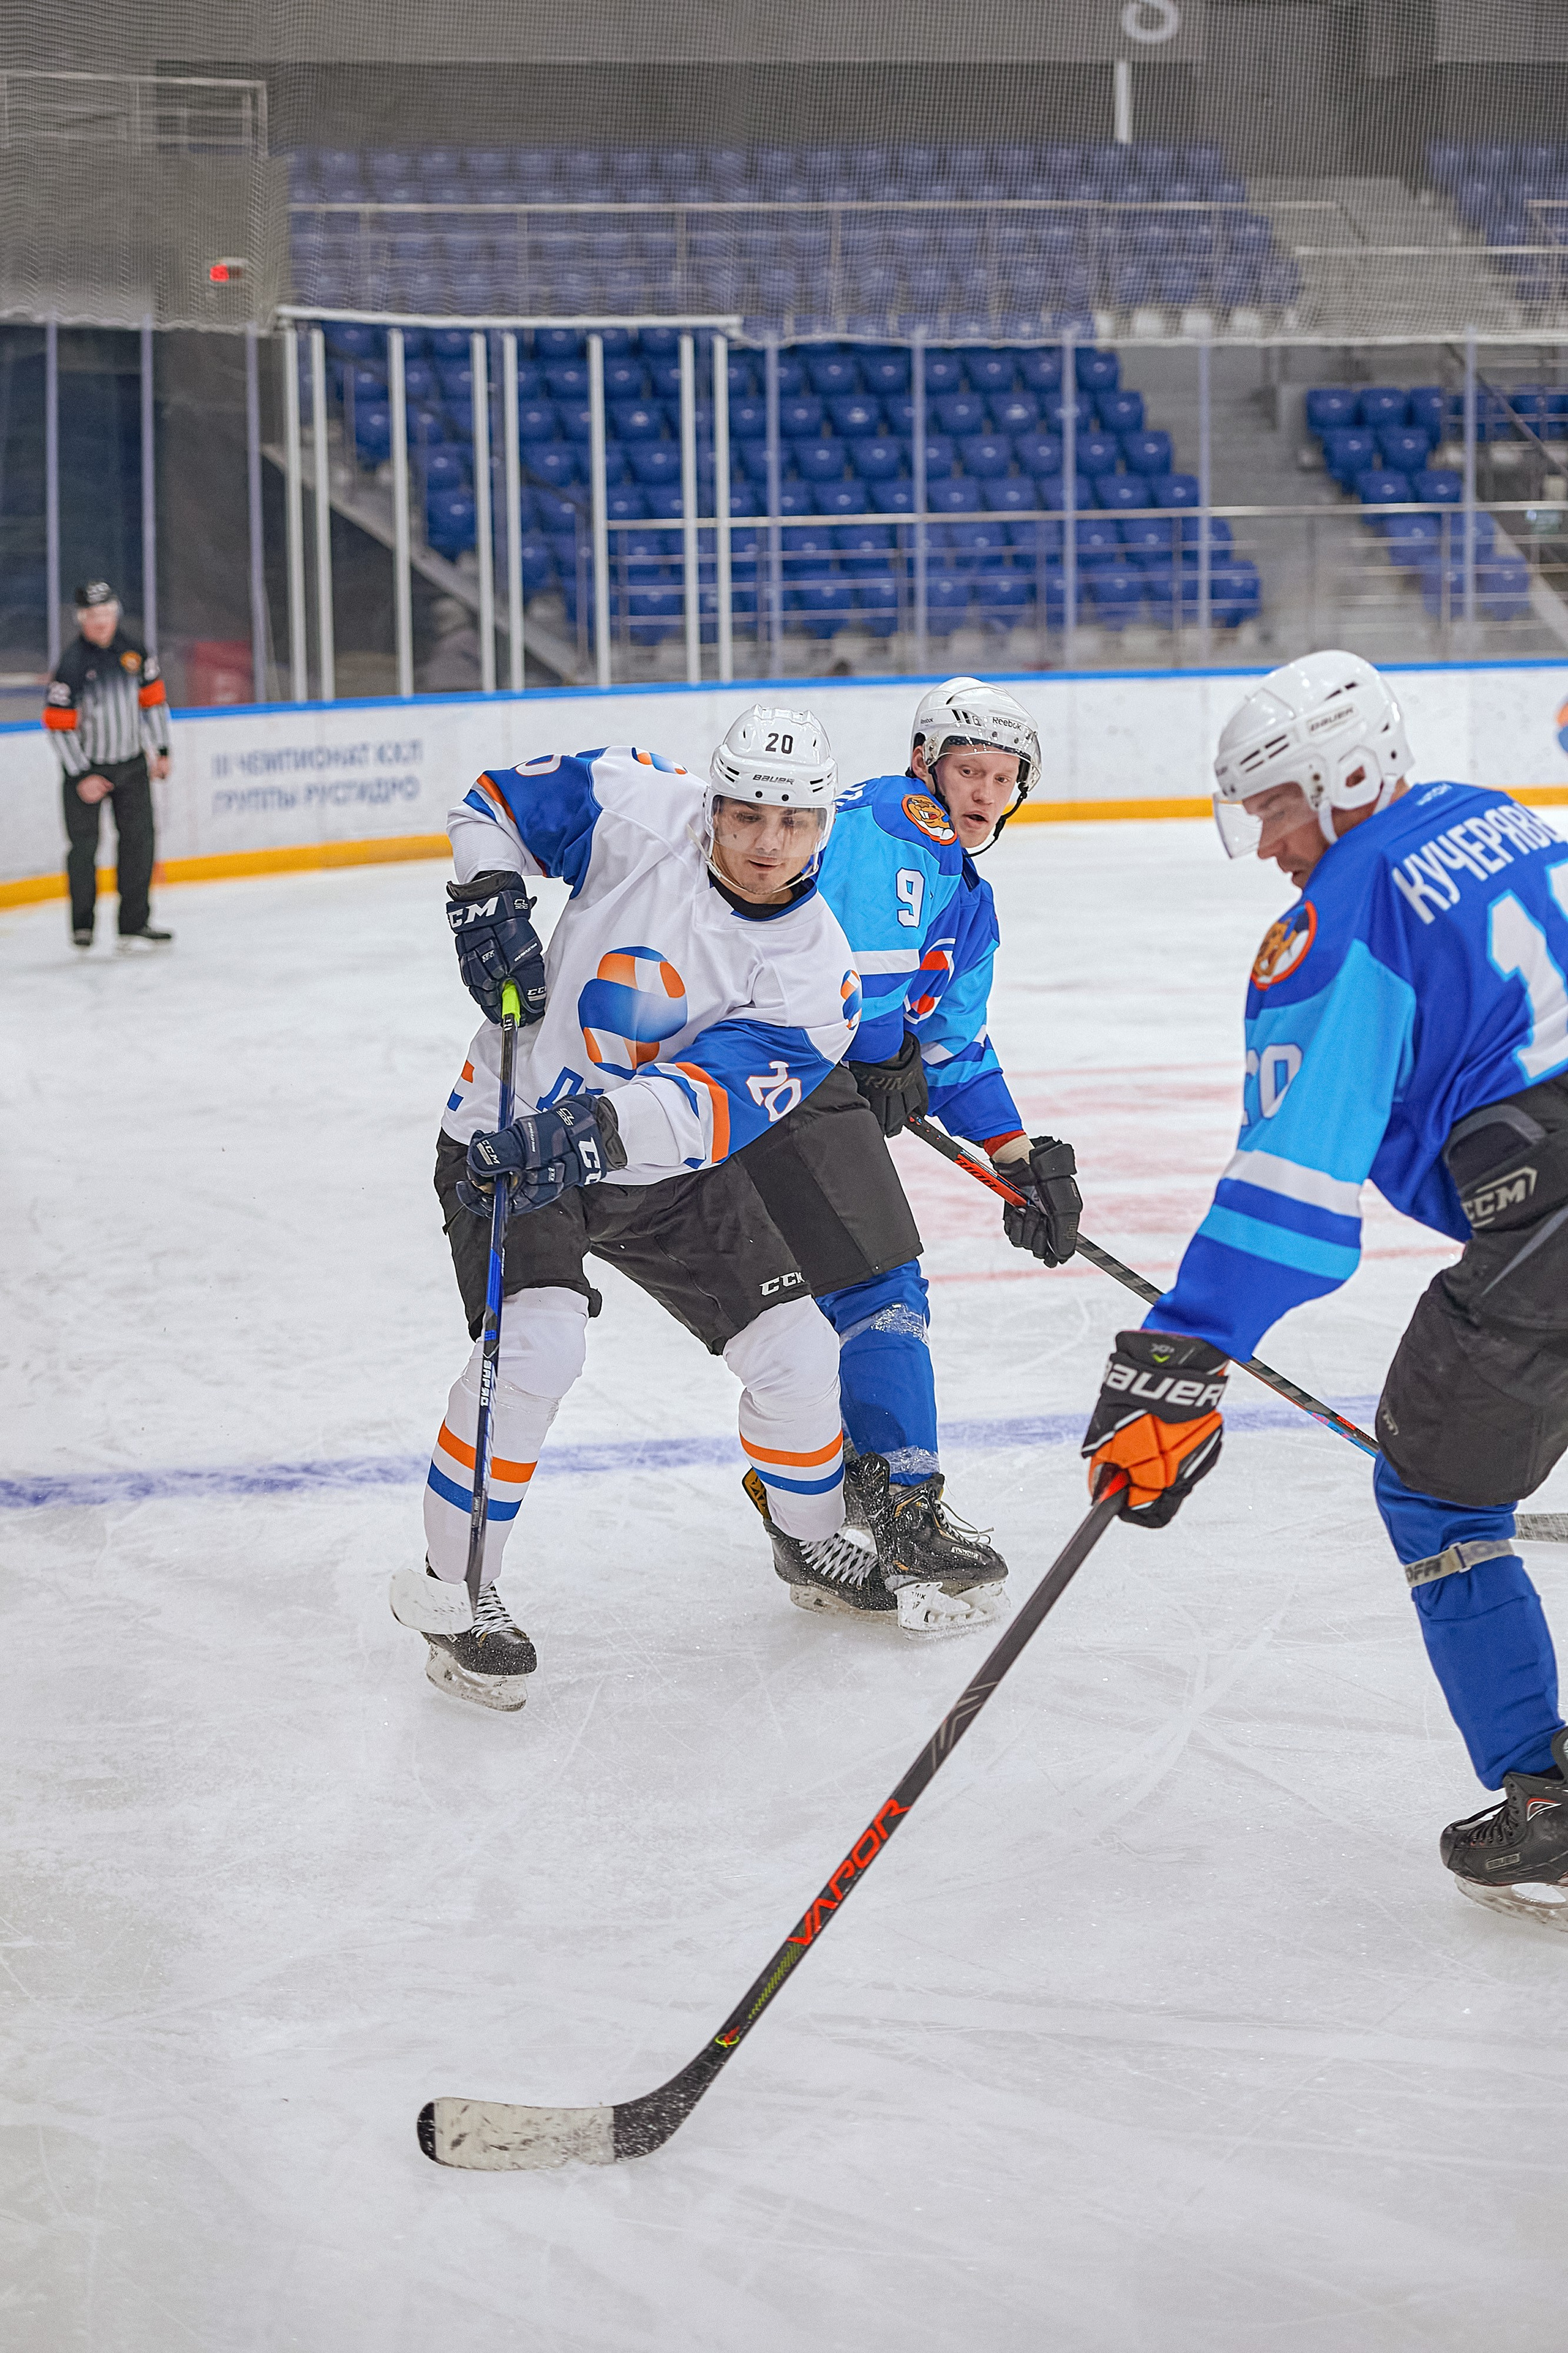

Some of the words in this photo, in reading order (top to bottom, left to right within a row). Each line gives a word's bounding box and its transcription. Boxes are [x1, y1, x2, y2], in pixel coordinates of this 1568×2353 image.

[992, 717, 1022, 731] Reebok
[238, 742, 369, 775] ЧЕМПИОНАТ
[765, 732, 793, 755] 20
[213, 785, 298, 815] ГРУППЫ
[304, 775, 420, 806] РУСГИДРО
[745, 1060, 802, 1122] 20
[481, 1139, 500, 1165] CCM
[759, 1271, 805, 1296] CCM
[480, 1360, 492, 1407] ЗАРЯД
[1104, 1361, 1225, 1407] AUER
[787, 1798, 911, 1946] VAPOR
